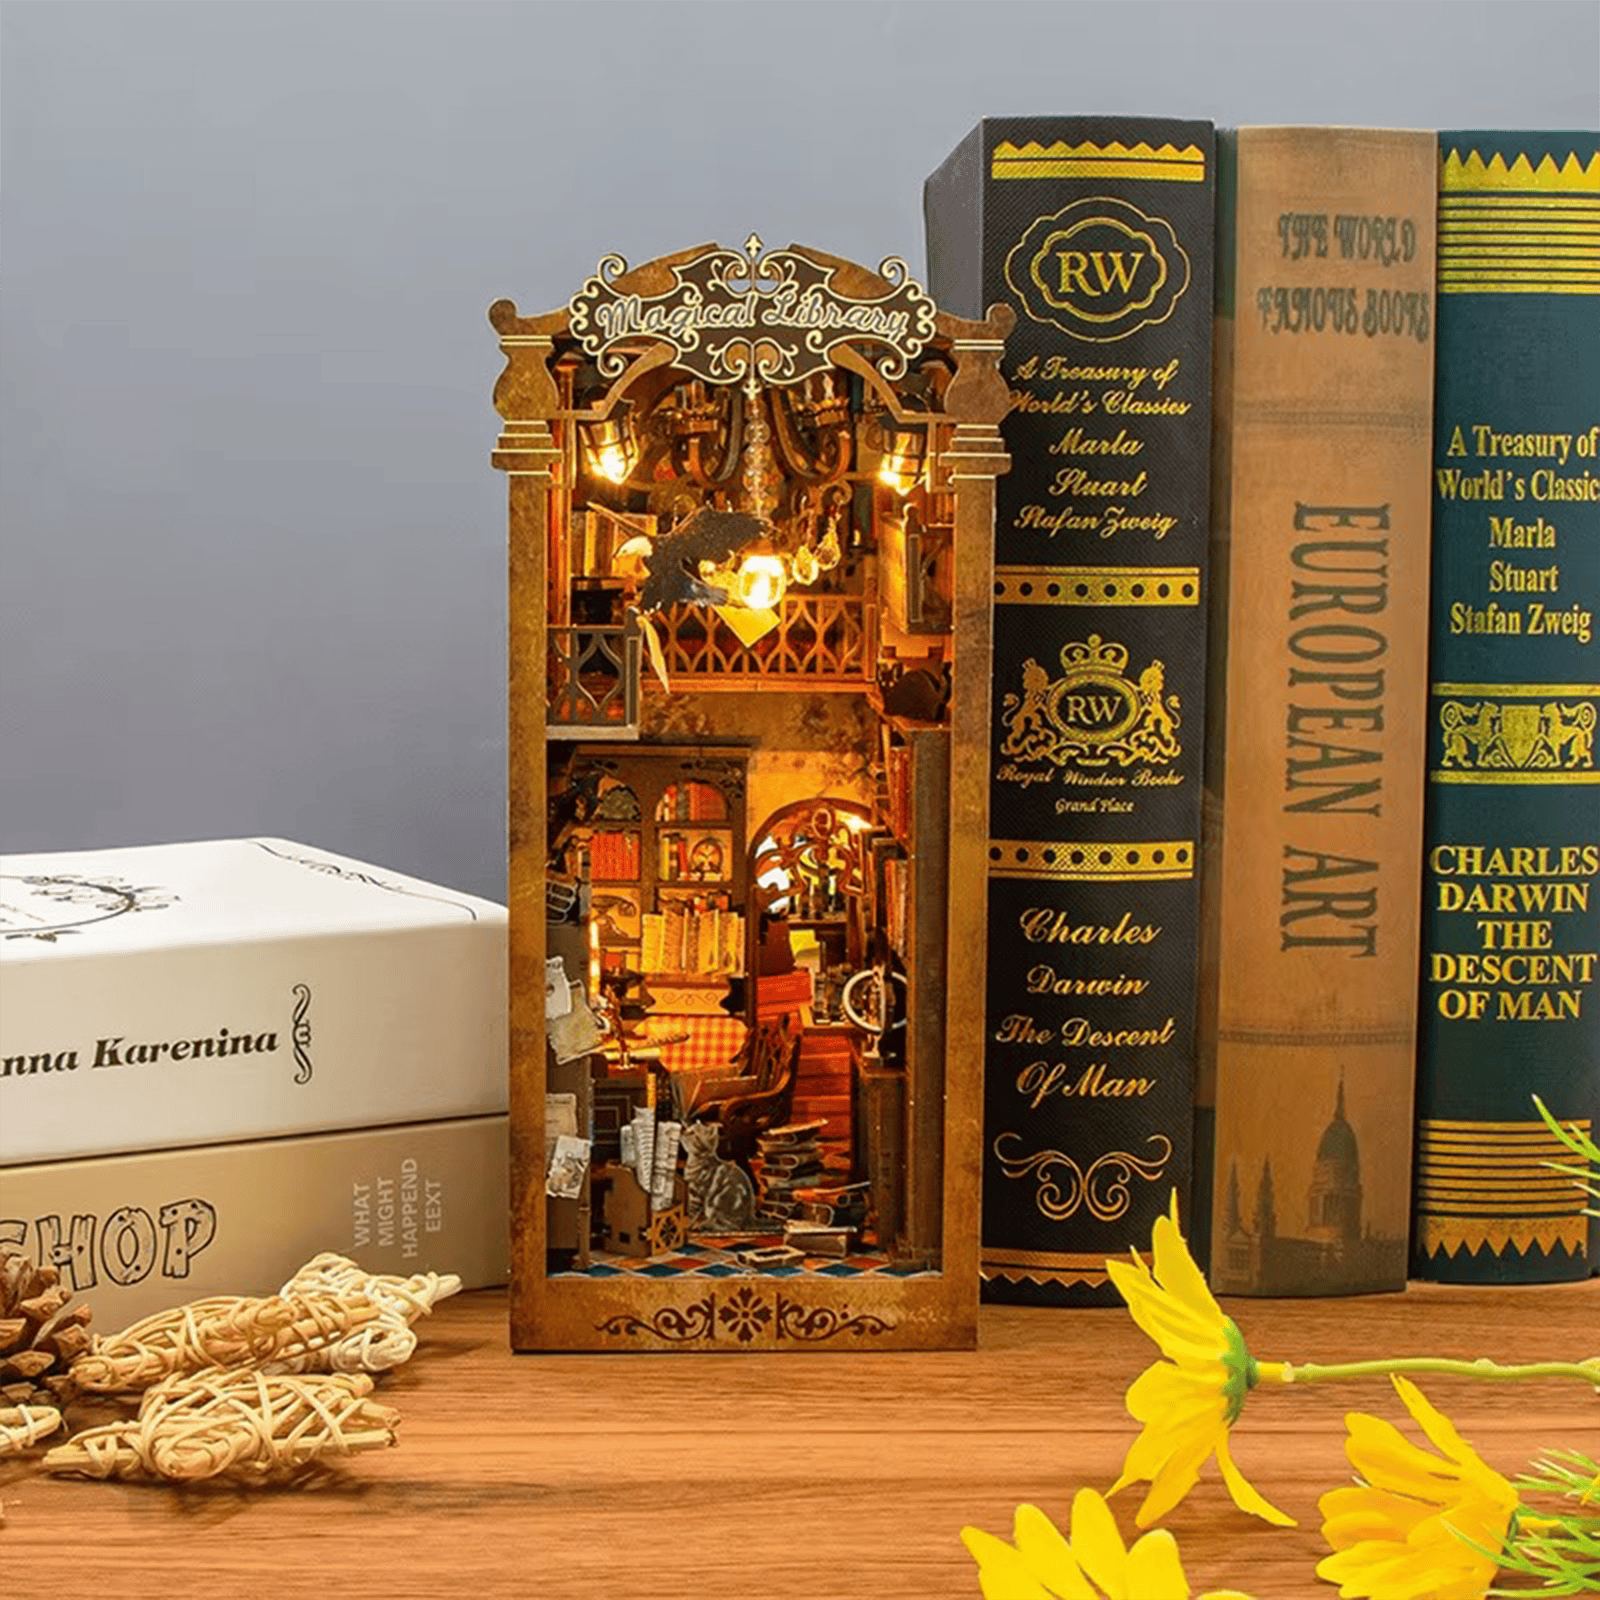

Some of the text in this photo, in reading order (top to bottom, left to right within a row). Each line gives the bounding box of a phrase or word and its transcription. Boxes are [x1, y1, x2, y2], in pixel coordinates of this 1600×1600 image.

[1056, 252, 1144, 297] RW
[595, 288, 910, 342] Magical Library
[1040, 356, 1151, 389] Treasury
[1152, 359, 1180, 390] of
[1102, 390, 1192, 415] Classics
[1048, 428, 1144, 455] Marla
[1447, 425, 1600, 466] A Treasury of
[1048, 468, 1148, 496] Stuart
[1437, 468, 1600, 501] World's Classic
[1013, 505, 1178, 540] Stafan Zweig
[1488, 516, 1556, 548] Marla
[1488, 560, 1559, 593] Stuart
[1450, 602, 1592, 644] Stafan Zweig
[1065, 696, 1122, 724] RW
[1280, 501, 1391, 959] EUROPEAN ART
[997, 764, 1055, 788] Royal
[1063, 770, 1127, 786] Windsor
[1055, 798, 1134, 814] Grand Place
[1430, 845, 1599, 875] CHARLES
[1437, 882, 1590, 913] DARWIN
[1020, 908, 1162, 945] Charles
[1477, 920, 1553, 949] THE
[1026, 964, 1149, 995] Darwin
[1430, 953, 1598, 985] DESCENT
[1438, 990, 1582, 1020] OF MAN
[996, 1014, 1177, 1047] The Descent
[0, 1028, 279, 1078] nna Karenina
[1016, 1061, 1157, 1109] Of Man
[353, 1183, 370, 1248] WHAT
[377, 1177, 394, 1247] MIGHT
[401, 1158, 418, 1258] HAPPEND
[425, 1178, 441, 1232] EEXT
